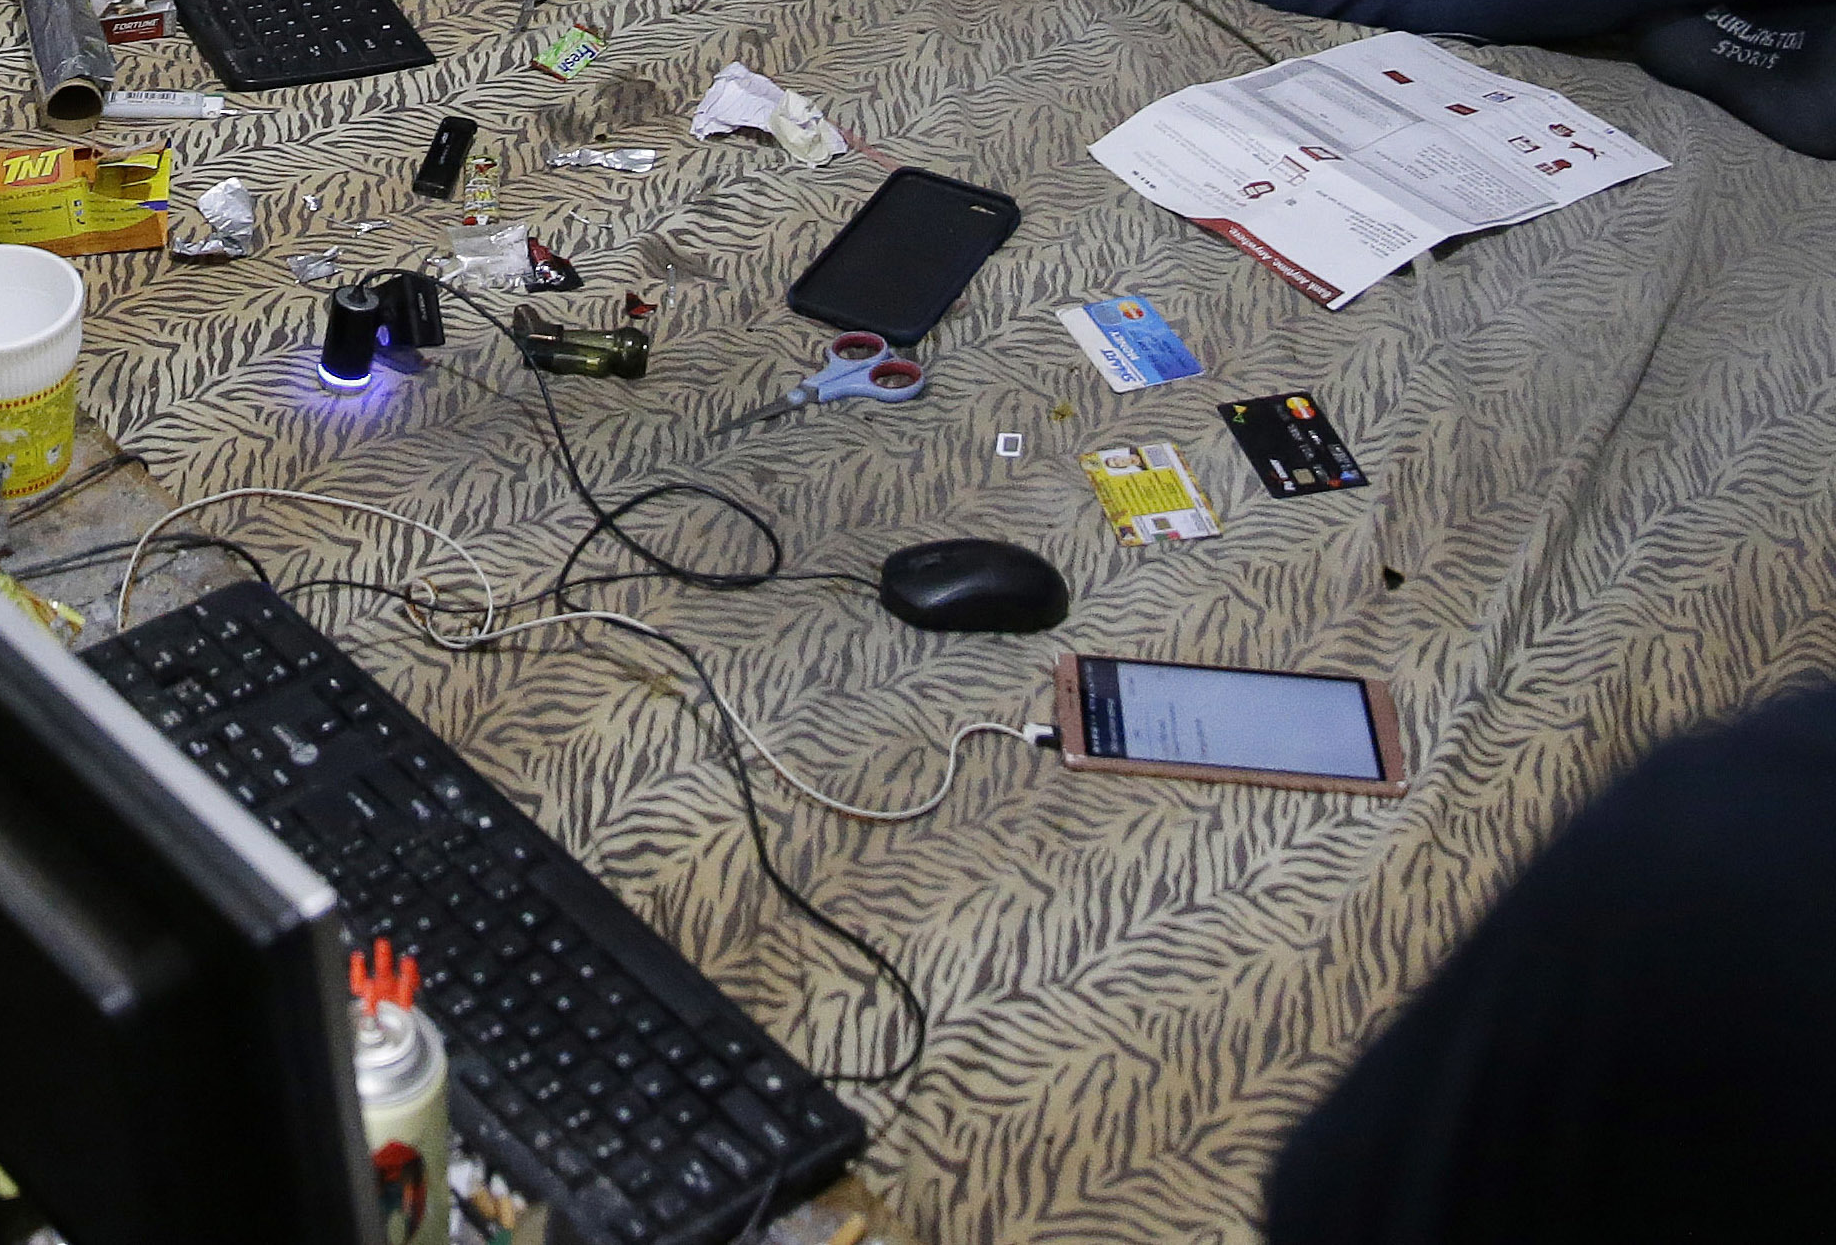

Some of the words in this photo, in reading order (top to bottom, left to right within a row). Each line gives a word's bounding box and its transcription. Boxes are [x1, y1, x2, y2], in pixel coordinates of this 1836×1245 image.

[112, 18, 160, 32] FORTUNE
[557, 44, 598, 73] Fresh
[2, 147, 67, 185] TNT
